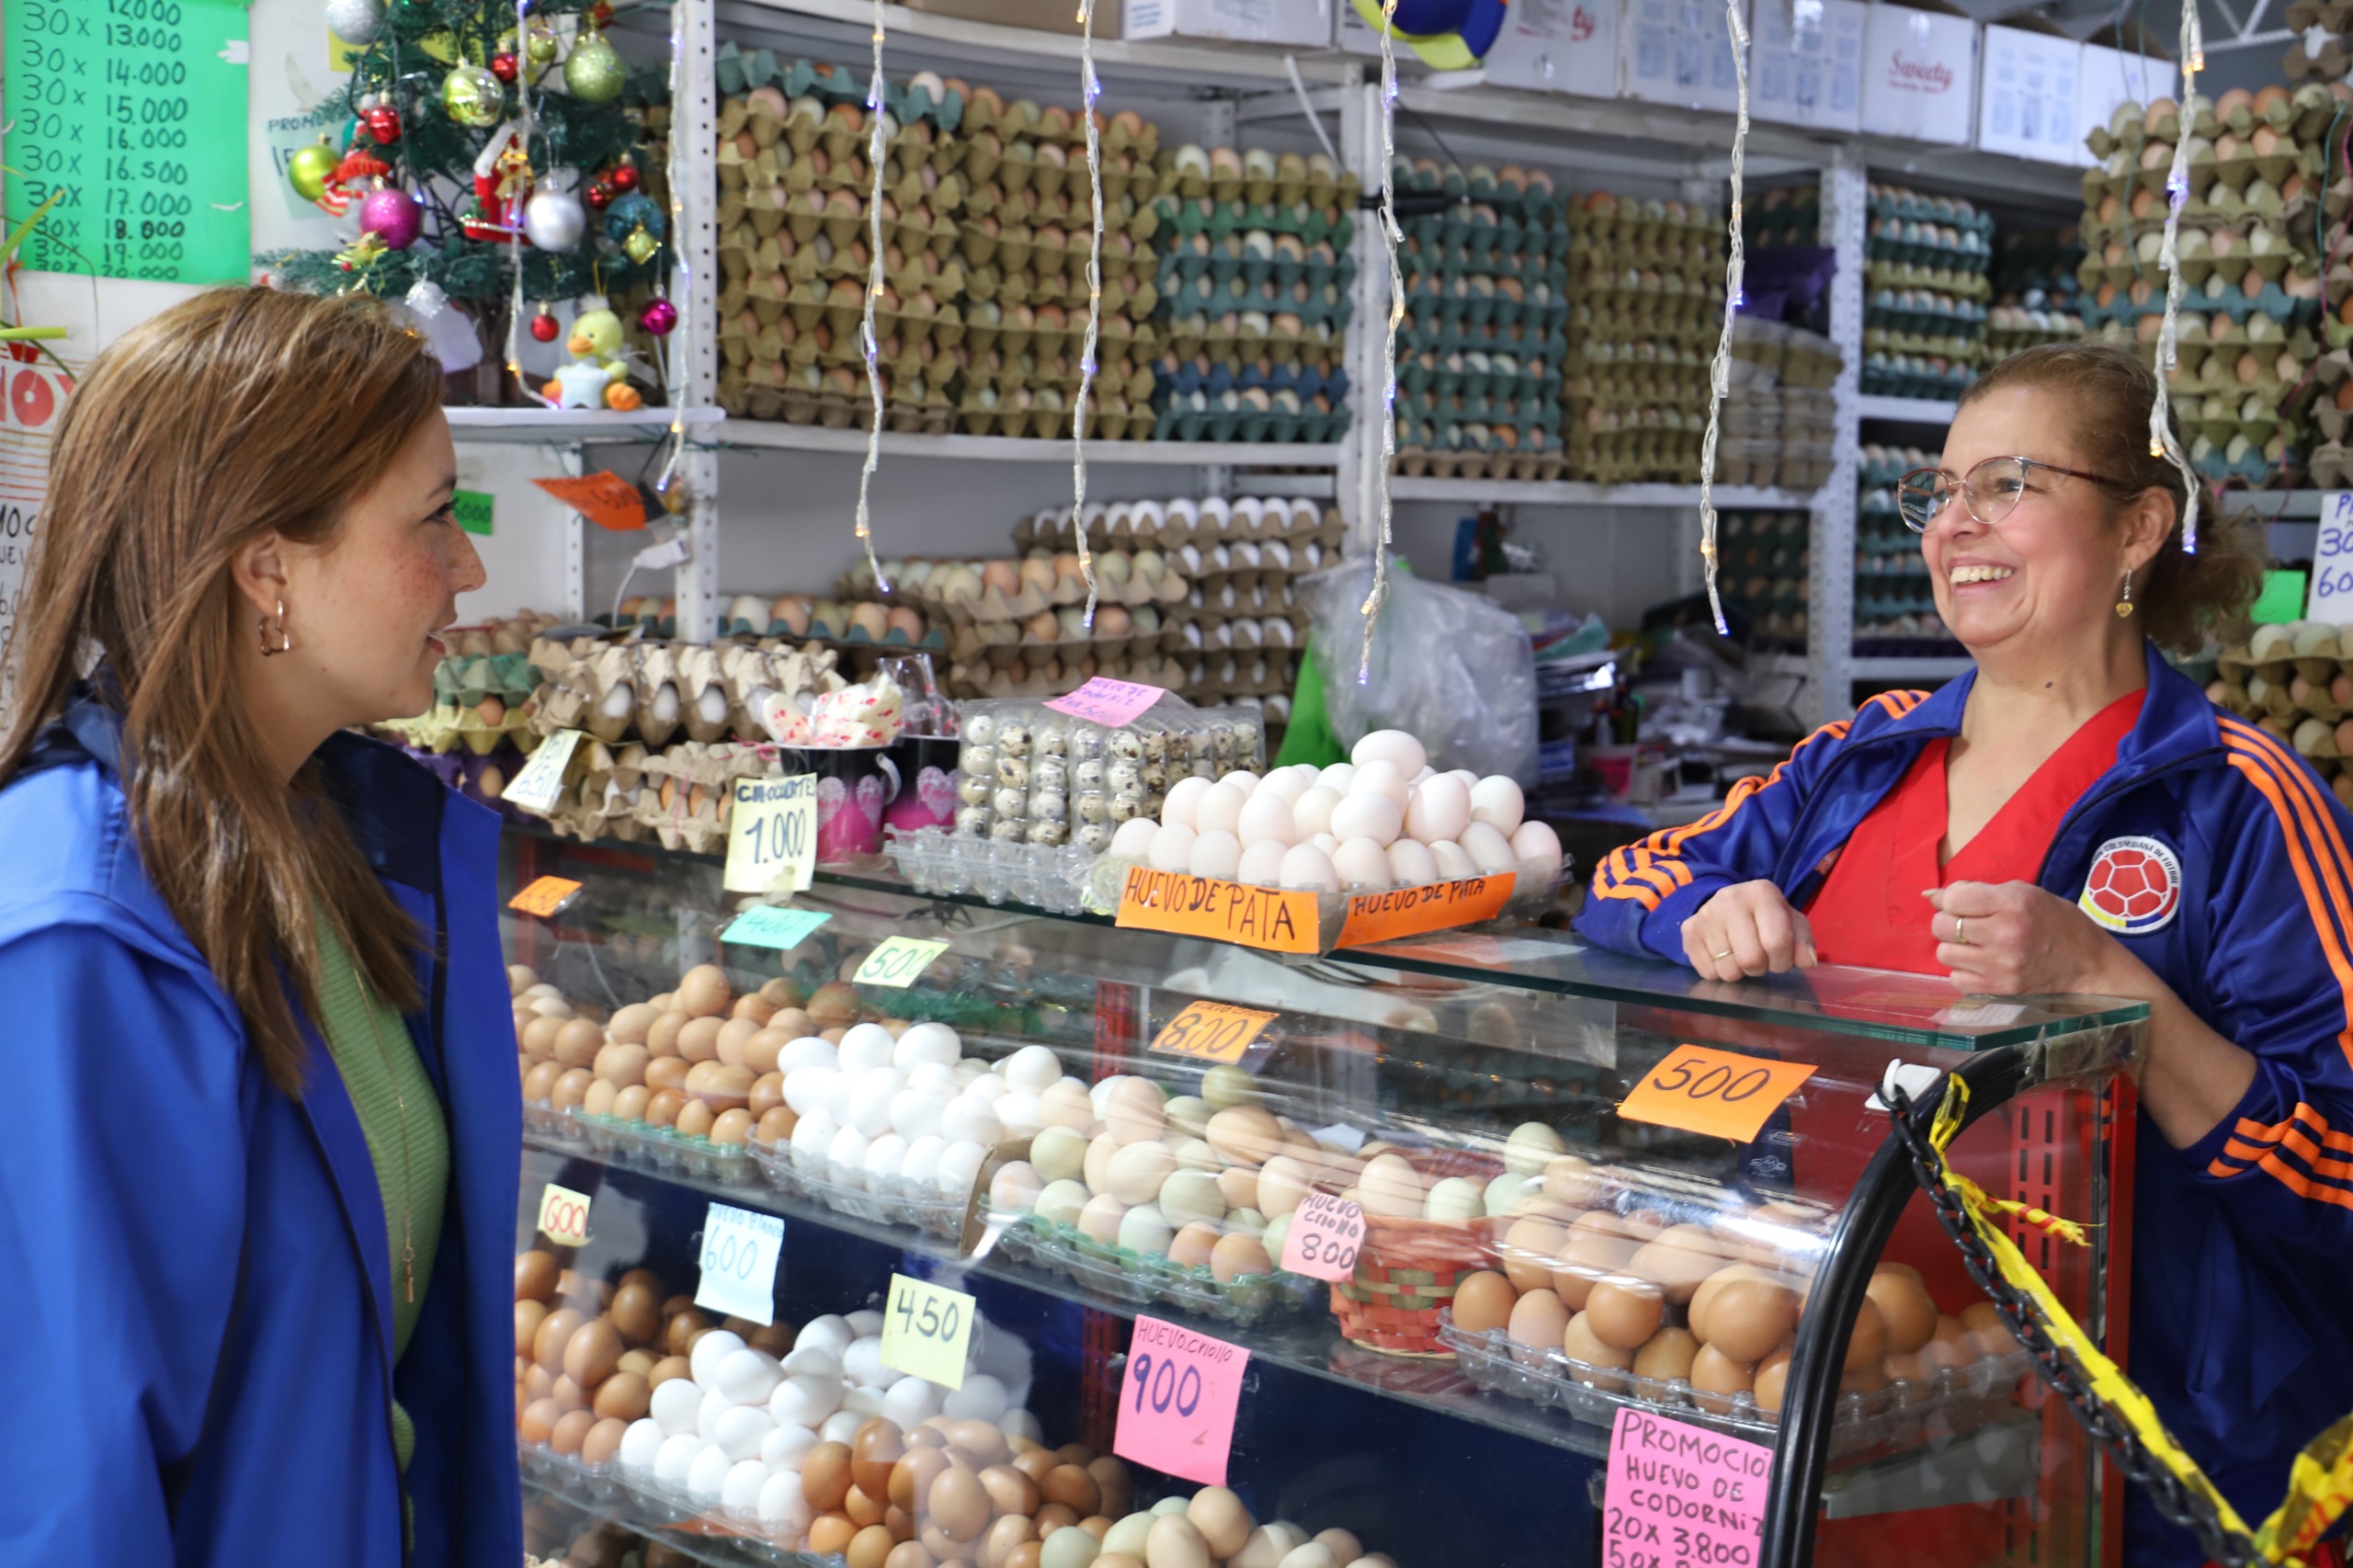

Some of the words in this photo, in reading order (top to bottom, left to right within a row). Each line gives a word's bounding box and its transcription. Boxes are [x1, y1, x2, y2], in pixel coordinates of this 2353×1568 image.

[106, 22, 182, 52] 13.000
[107, 58, 187, 86] 14.000
[107, 94, 188, 125] 15.000
[107, 126, 188, 150] 16.000
[105, 154, 188, 186] 16.500
[106, 187, 191, 217] 17.000
[106, 218, 186, 240] 18.000
[104, 242, 184, 265] 19.000
[745, 808, 806, 865] 1.000
[1124, 868, 1188, 914] HUEVO
[1188, 877, 1222, 913] DE
[1224, 882, 1296, 943] PATA
[1354, 891, 1418, 917] HUEVO
[1422, 883, 1445, 903] DE
[1448, 877, 1486, 904] PATA
[862, 947, 936, 980] 500
[1160, 1012, 1250, 1055] 800
[1653, 1058, 1771, 1102] 500
[544, 1194, 587, 1238] 600
[1302, 1193, 1362, 1220] HUEVO
[705, 1224, 758, 1281] 600
[1302, 1233, 1356, 1270] 800
[897, 1287, 960, 1343] 450
[1132, 1352, 1201, 1418] 900
[1626, 1454, 1699, 1490] HUEVO
[1712, 1476, 1745, 1503] DE
[1673, 1526, 1751, 1566] 3.800
